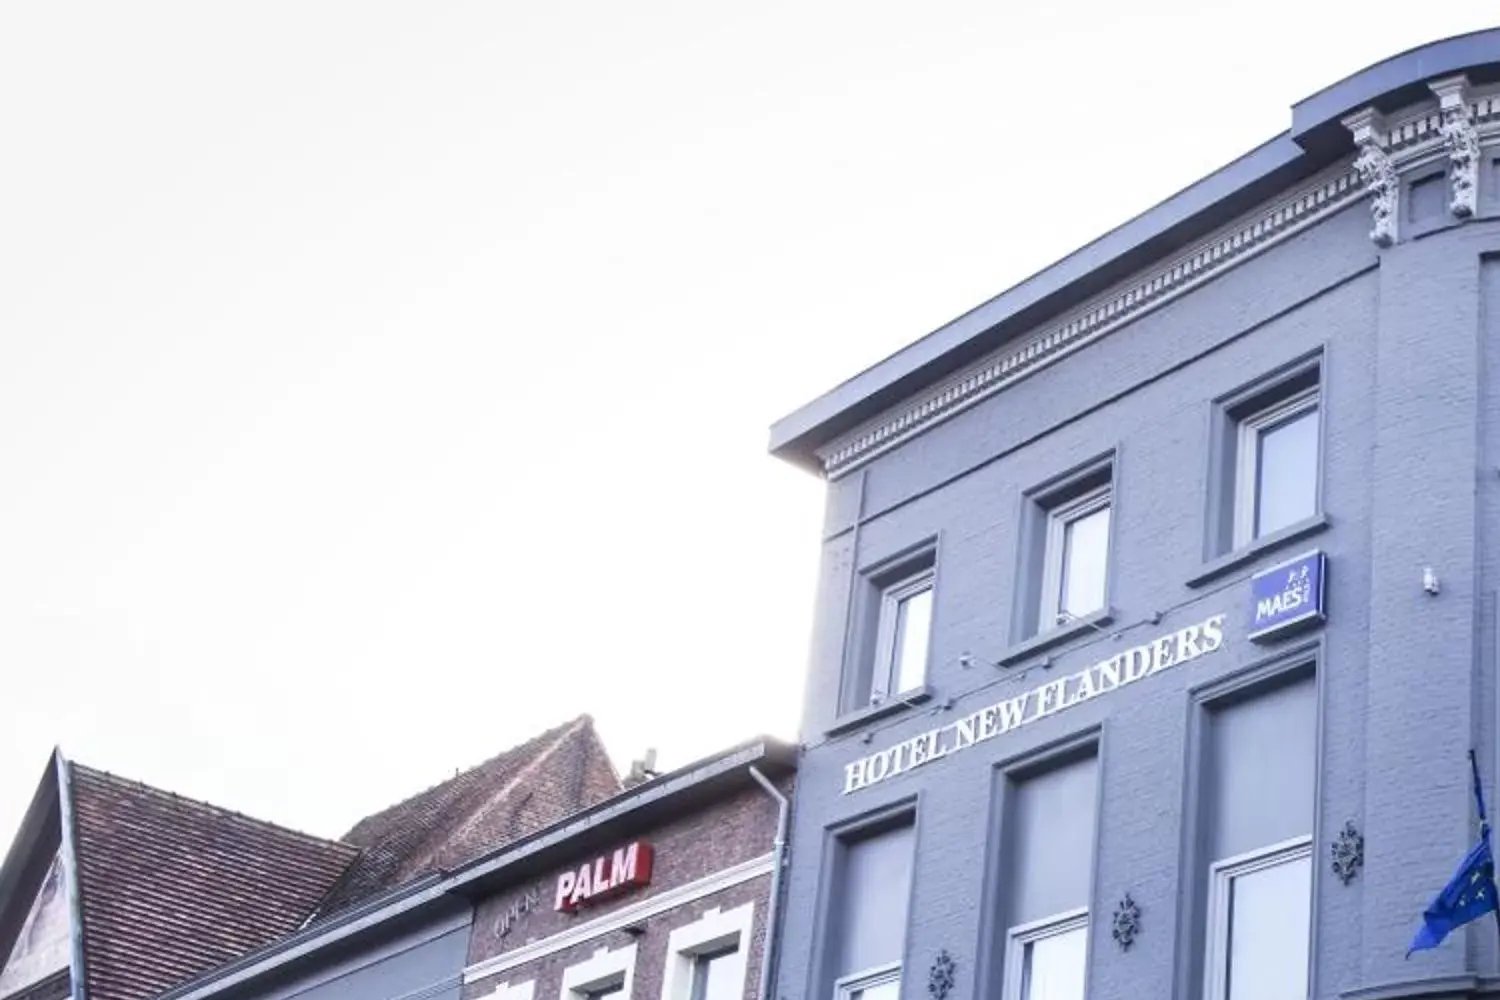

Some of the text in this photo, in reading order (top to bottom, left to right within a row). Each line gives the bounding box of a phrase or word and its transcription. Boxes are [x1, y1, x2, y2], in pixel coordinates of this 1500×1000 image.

[1256, 588, 1302, 623] MAES
[843, 614, 1227, 795] HOTEL NEW FLANDERS
[554, 841, 639, 911] PALM
